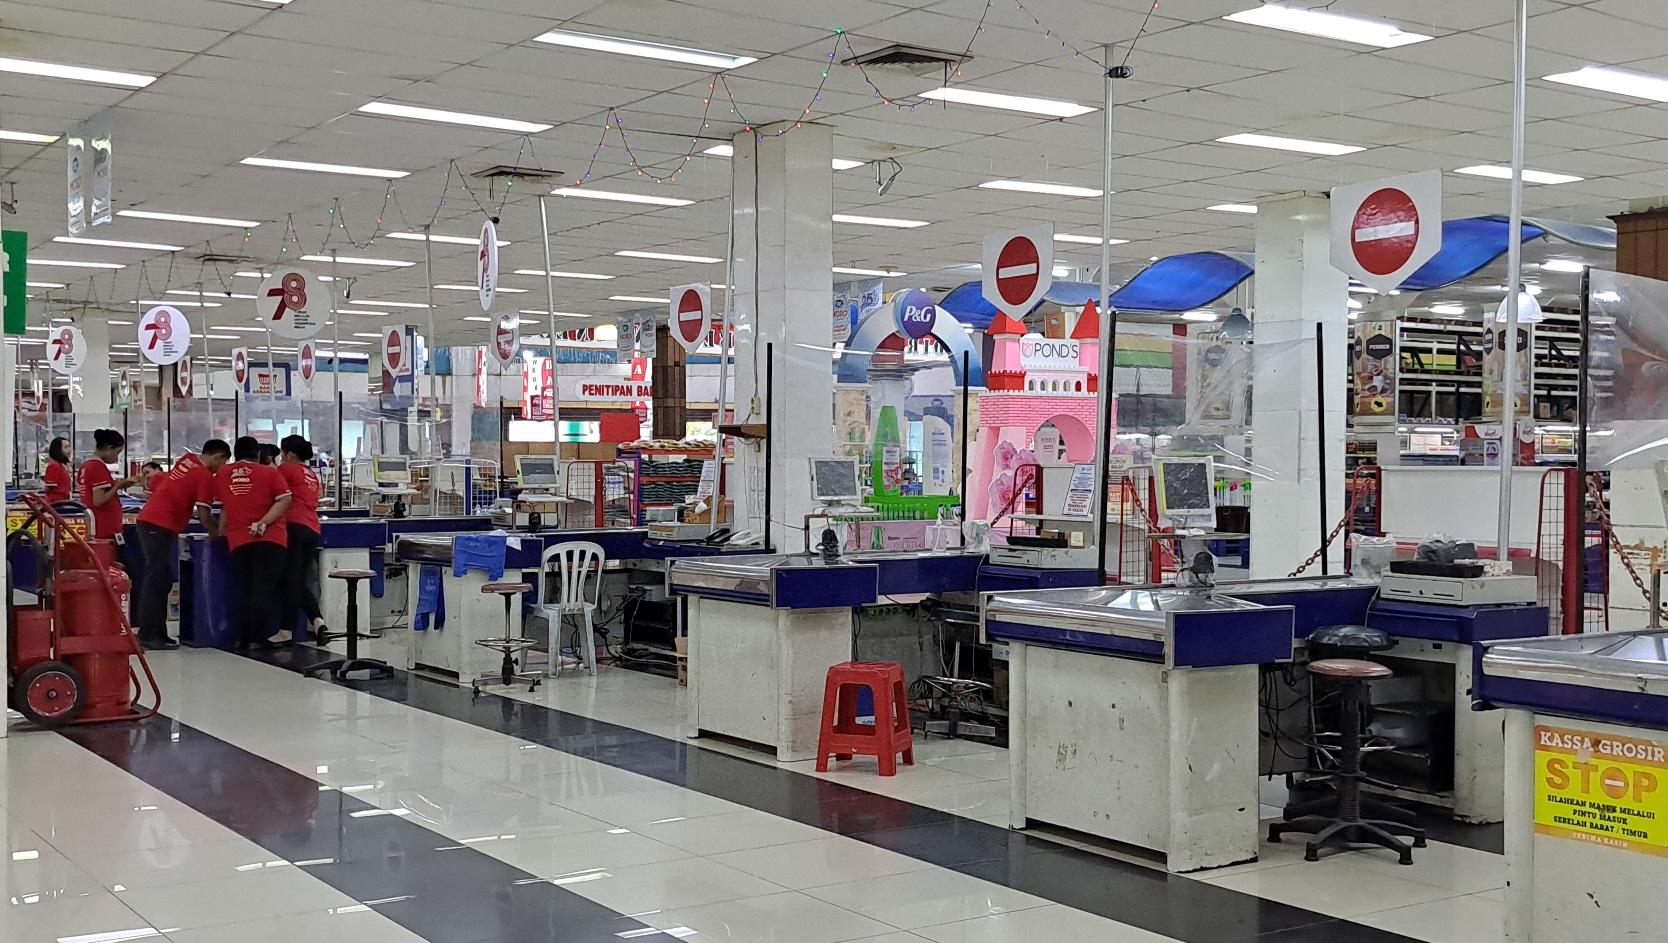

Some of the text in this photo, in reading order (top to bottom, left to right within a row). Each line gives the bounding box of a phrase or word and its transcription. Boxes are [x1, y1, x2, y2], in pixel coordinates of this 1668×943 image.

[267, 273, 307, 321] 78
[904, 305, 933, 322] P&G
[144, 310, 172, 350] 78
[52, 328, 74, 361] 78
[1034, 342, 1079, 359] POND'S
[582, 384, 632, 397] PENITIPAN
[1540, 731, 1665, 763] KASSA GROSIR
[1545, 758, 1658, 803] STOP
[1547, 795, 1656, 820] SILAHKAN MASUK MELALUI
[1572, 809, 1628, 825] PINTU MASUK
[1553, 816, 1587, 828] SEBELAH
[1590, 823, 1615, 833] BARAT
[1622, 828, 1648, 839] TIMUR
